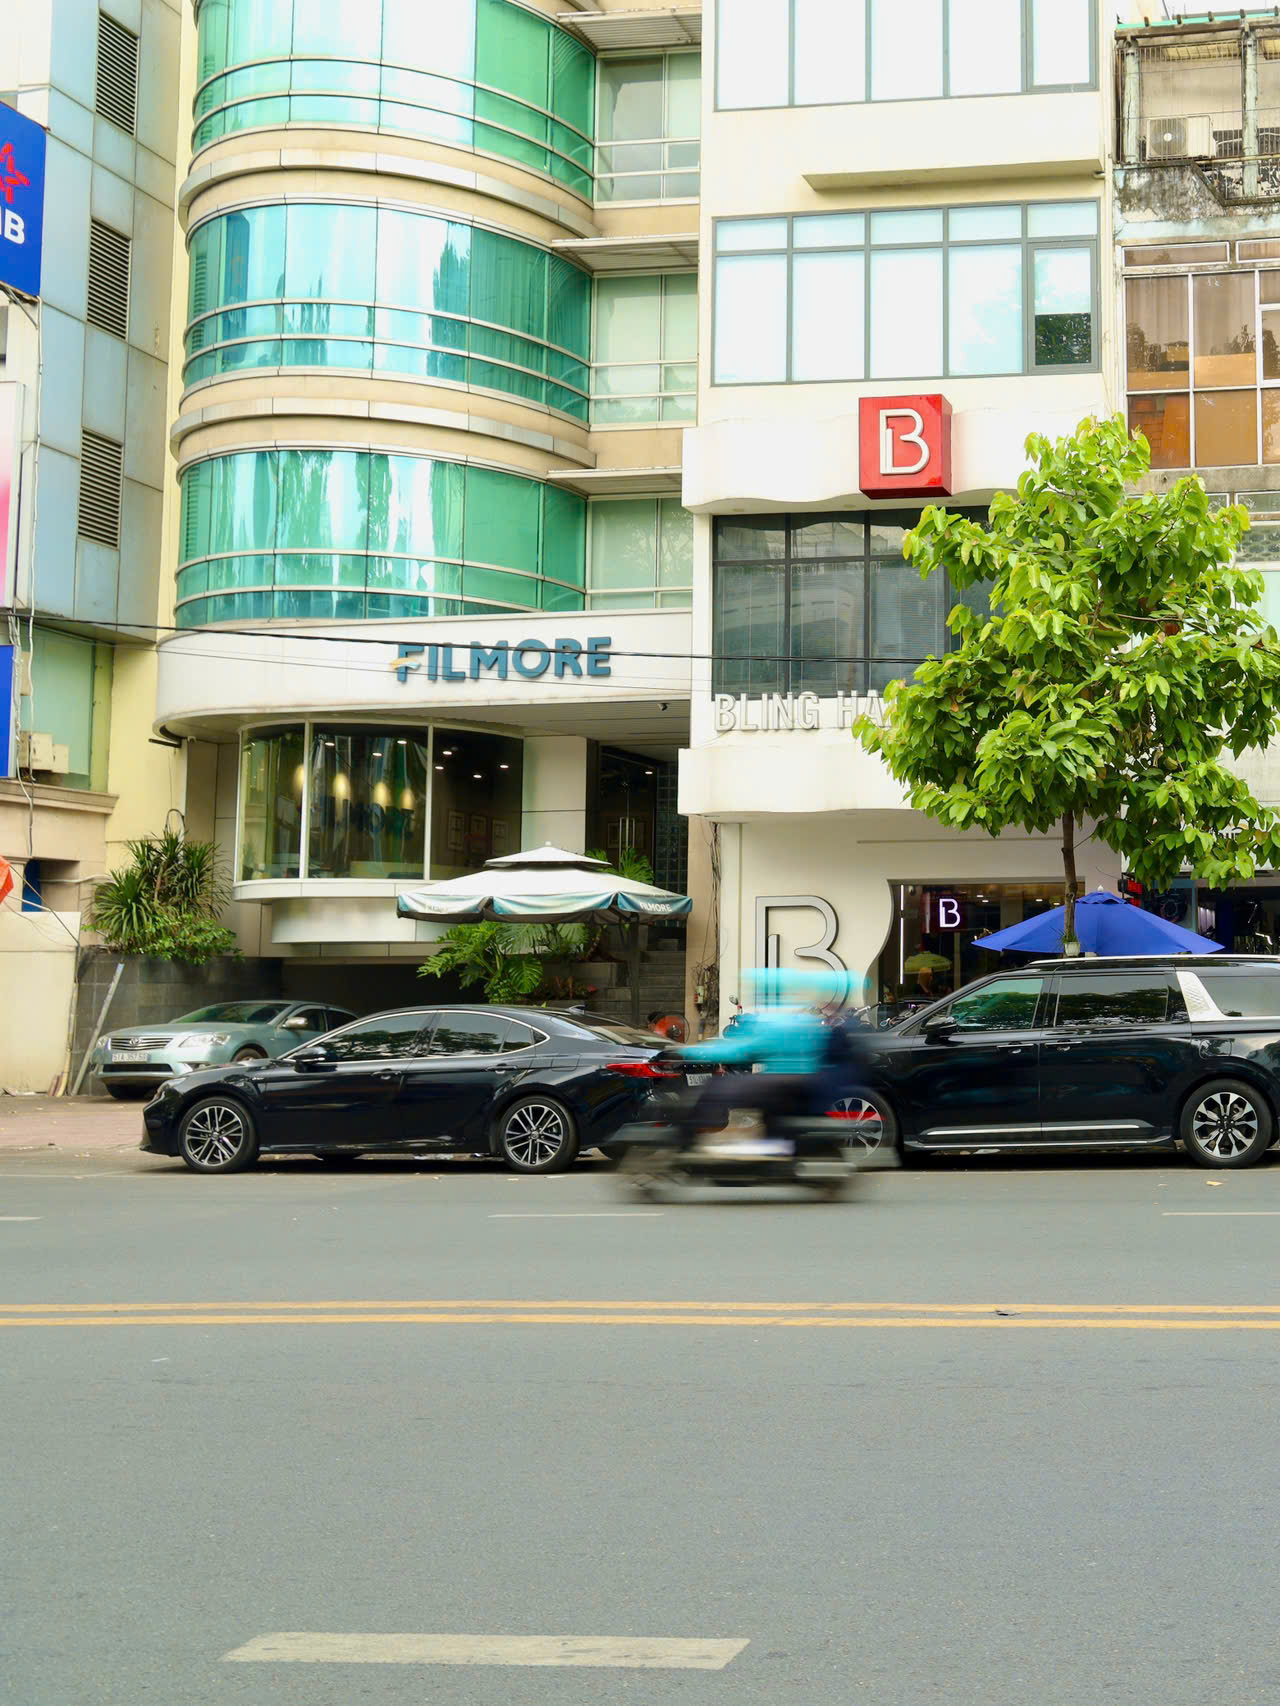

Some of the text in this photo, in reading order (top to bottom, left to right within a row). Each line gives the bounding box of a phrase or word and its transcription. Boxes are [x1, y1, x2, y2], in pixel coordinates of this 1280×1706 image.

[0, 205, 25, 245] B
[879, 408, 930, 476] B
[396, 636, 612, 684] FILMORE
[714, 689, 898, 732] BLING HA
[939, 898, 961, 928] B
[755, 894, 849, 1020] B
